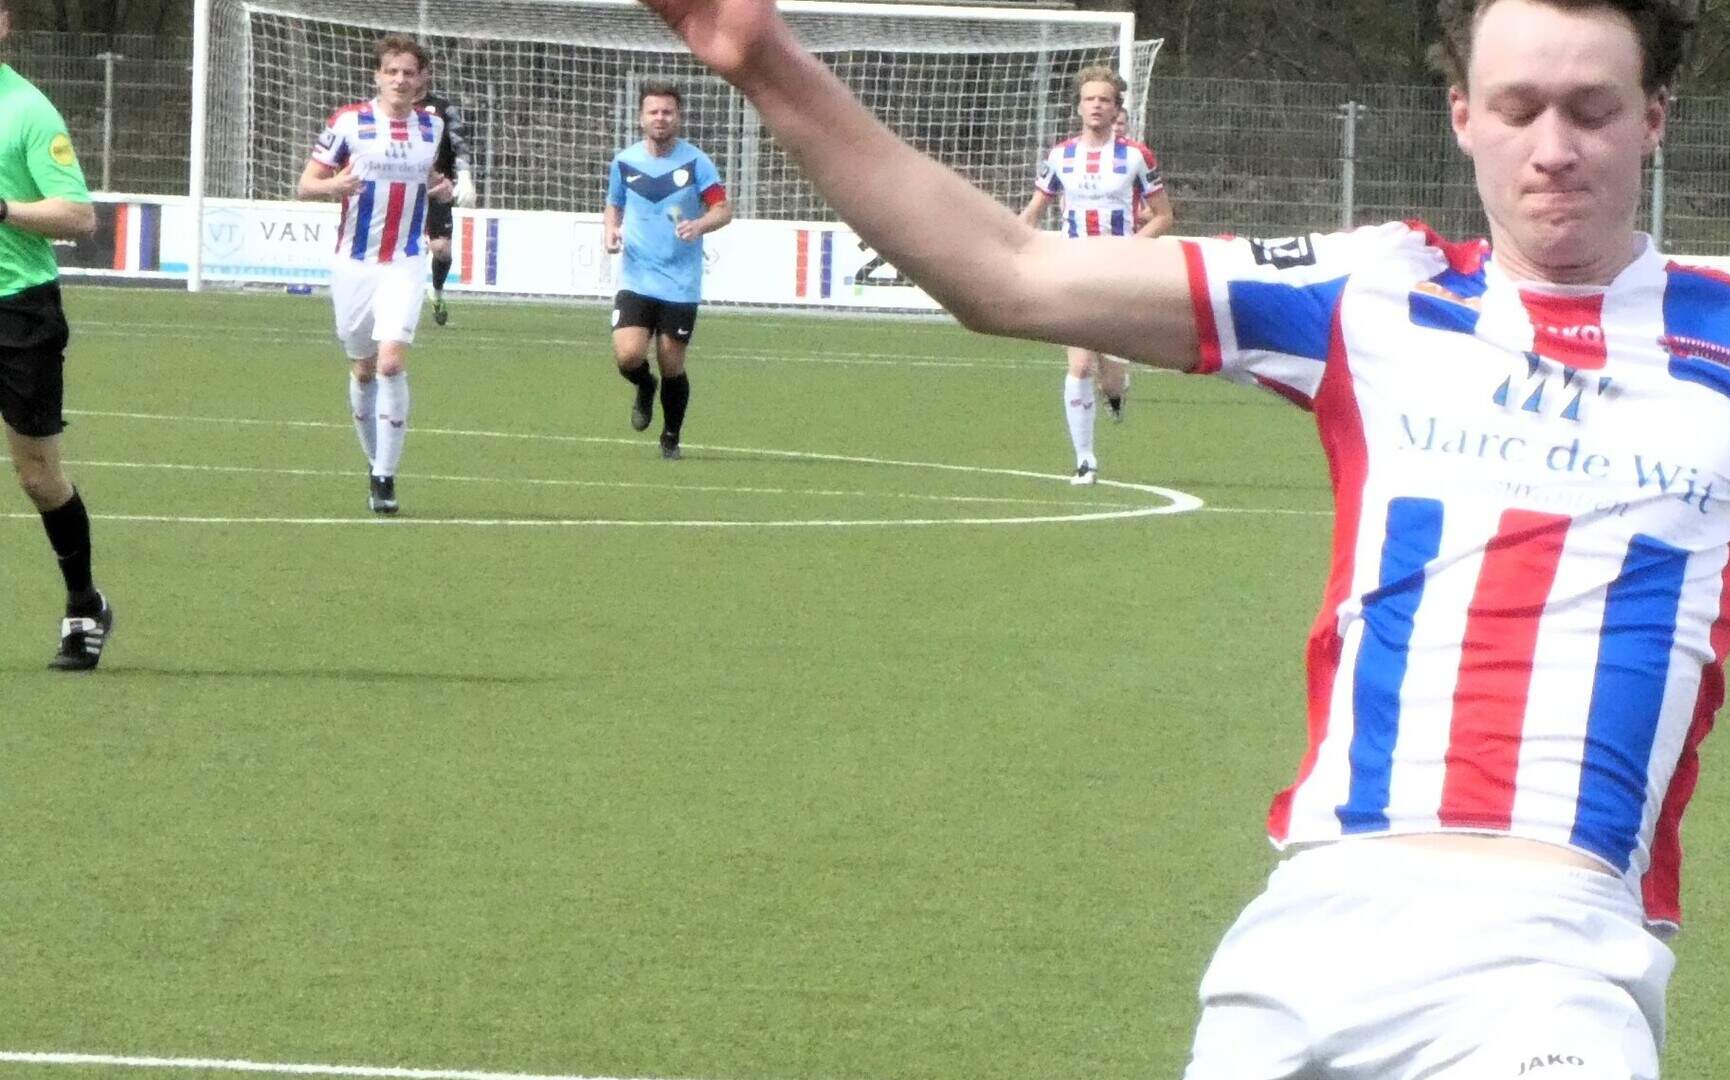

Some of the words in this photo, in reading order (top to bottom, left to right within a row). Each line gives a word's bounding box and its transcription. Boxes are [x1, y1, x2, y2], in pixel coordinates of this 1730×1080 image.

[260, 221, 321, 243] VAN
[1397, 414, 1527, 461] Marc
[1546, 438, 1611, 478] de
[1634, 454, 1713, 514] Wit
[1517, 1054, 1585, 1076] JAKO
